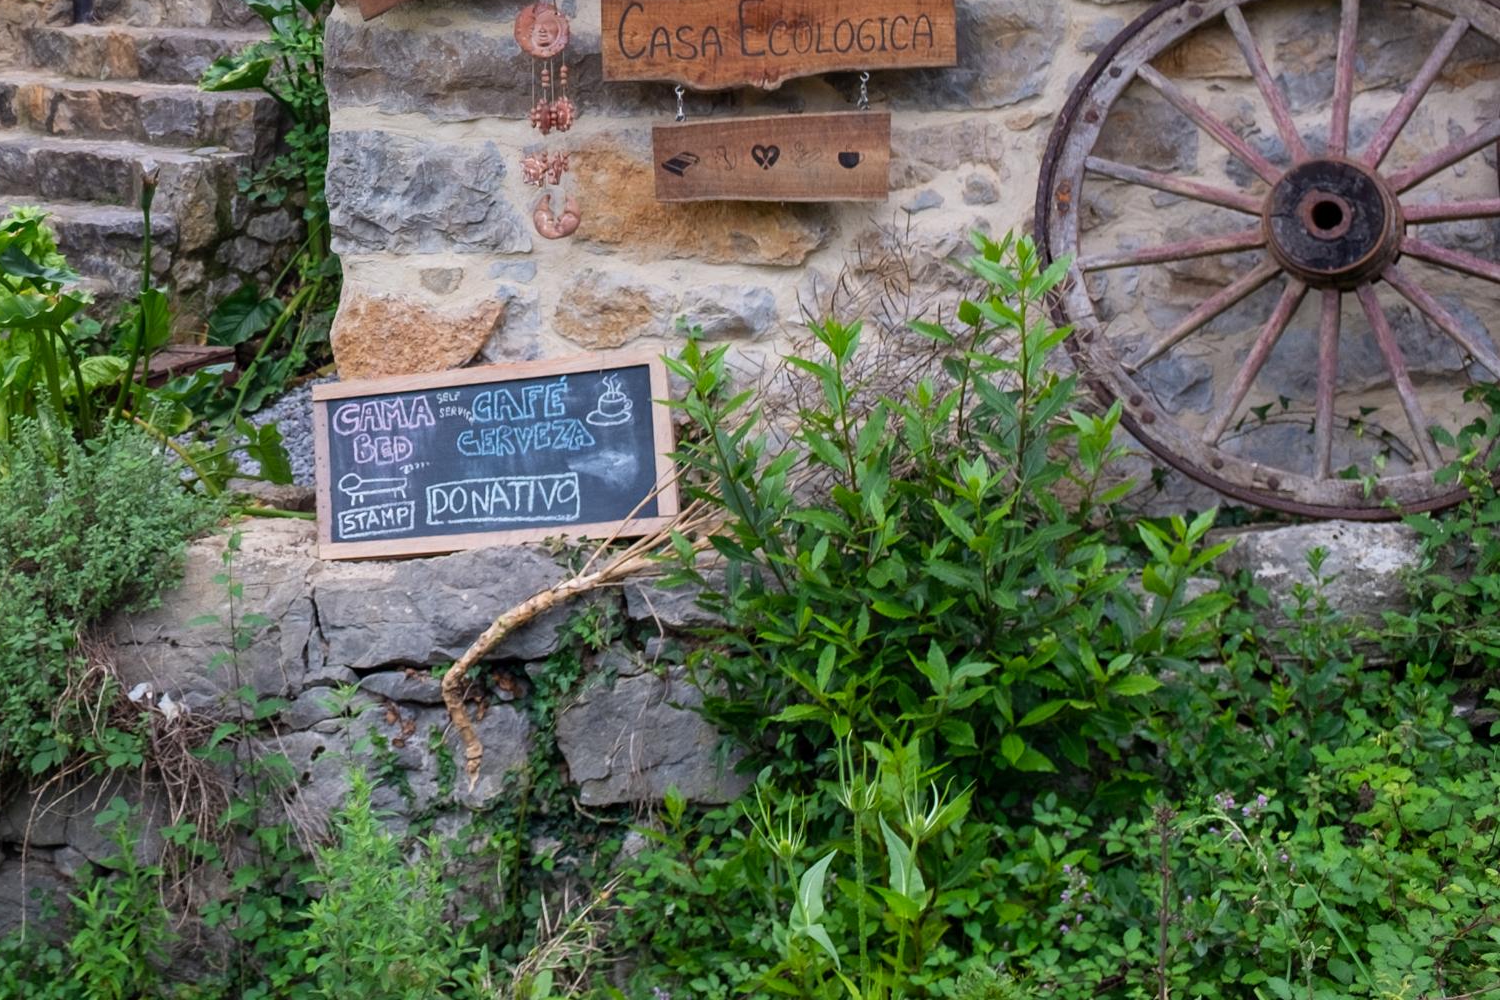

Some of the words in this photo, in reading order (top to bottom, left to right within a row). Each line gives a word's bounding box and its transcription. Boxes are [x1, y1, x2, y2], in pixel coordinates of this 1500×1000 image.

[618, 2, 723, 60] CASA
[332, 395, 436, 436] CAMA
[436, 391, 461, 404] SELF
[471, 375, 569, 423] CAFÉ
[353, 433, 414, 466] BED
[456, 418, 596, 457] CERVEZA
[431, 478, 578, 516] DONATIVO
[343, 506, 409, 533] STAMP
